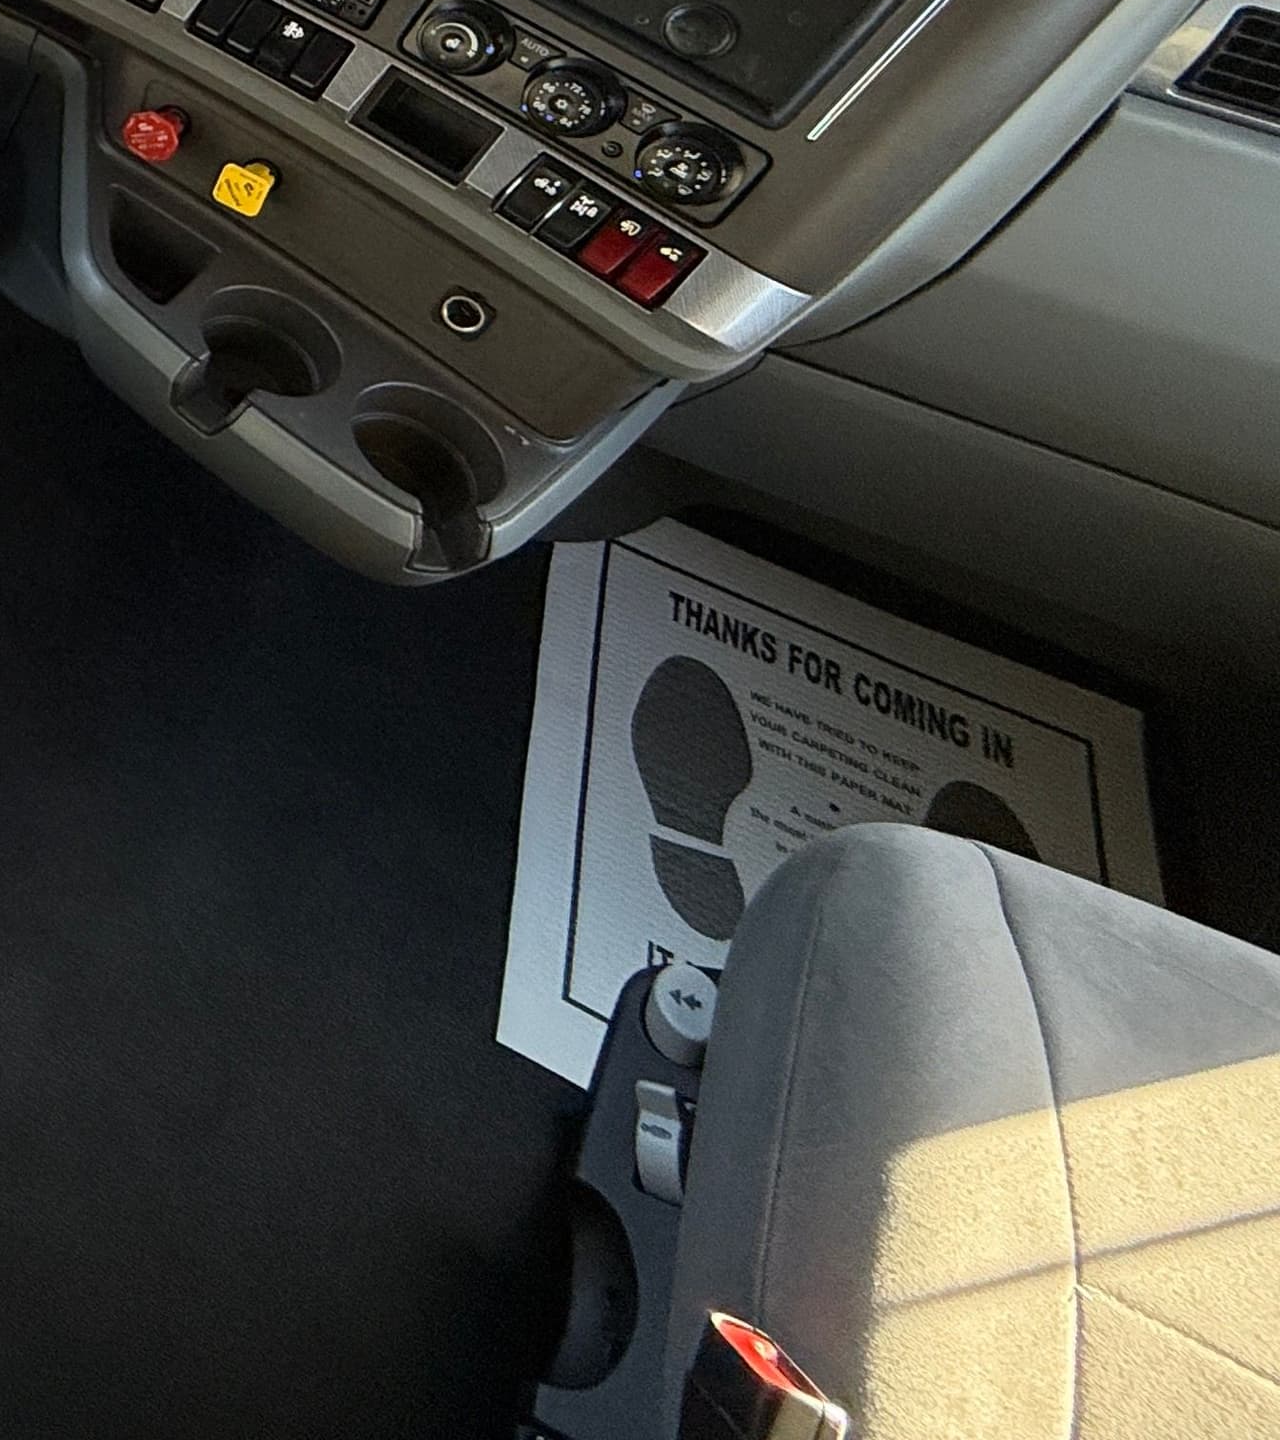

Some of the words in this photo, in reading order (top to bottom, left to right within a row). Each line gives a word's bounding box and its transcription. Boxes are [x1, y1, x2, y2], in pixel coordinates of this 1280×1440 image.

[520, 38, 550, 57] AUTO
[569, 82, 583, 94] 72
[669, 590, 778, 664] THANKS
[788, 643, 843, 694] FOR
[854, 672, 971, 749] COMING
[981, 723, 1015, 769] IN
[750, 711, 788, 736] YOUR
[791, 730, 869, 774] CARPETING
[872, 768, 922, 797] CLEAN
[774, 702, 813, 726] HAVE
[816, 720, 856, 745] TRIED
[859, 738, 878, 755] TO
[882, 749, 921, 772] KEEP
[758, 737, 791, 760] WITH
[794, 754, 827, 777] THIS
[831, 770, 878, 801] PAPER
[880, 794, 913, 816] MAT
